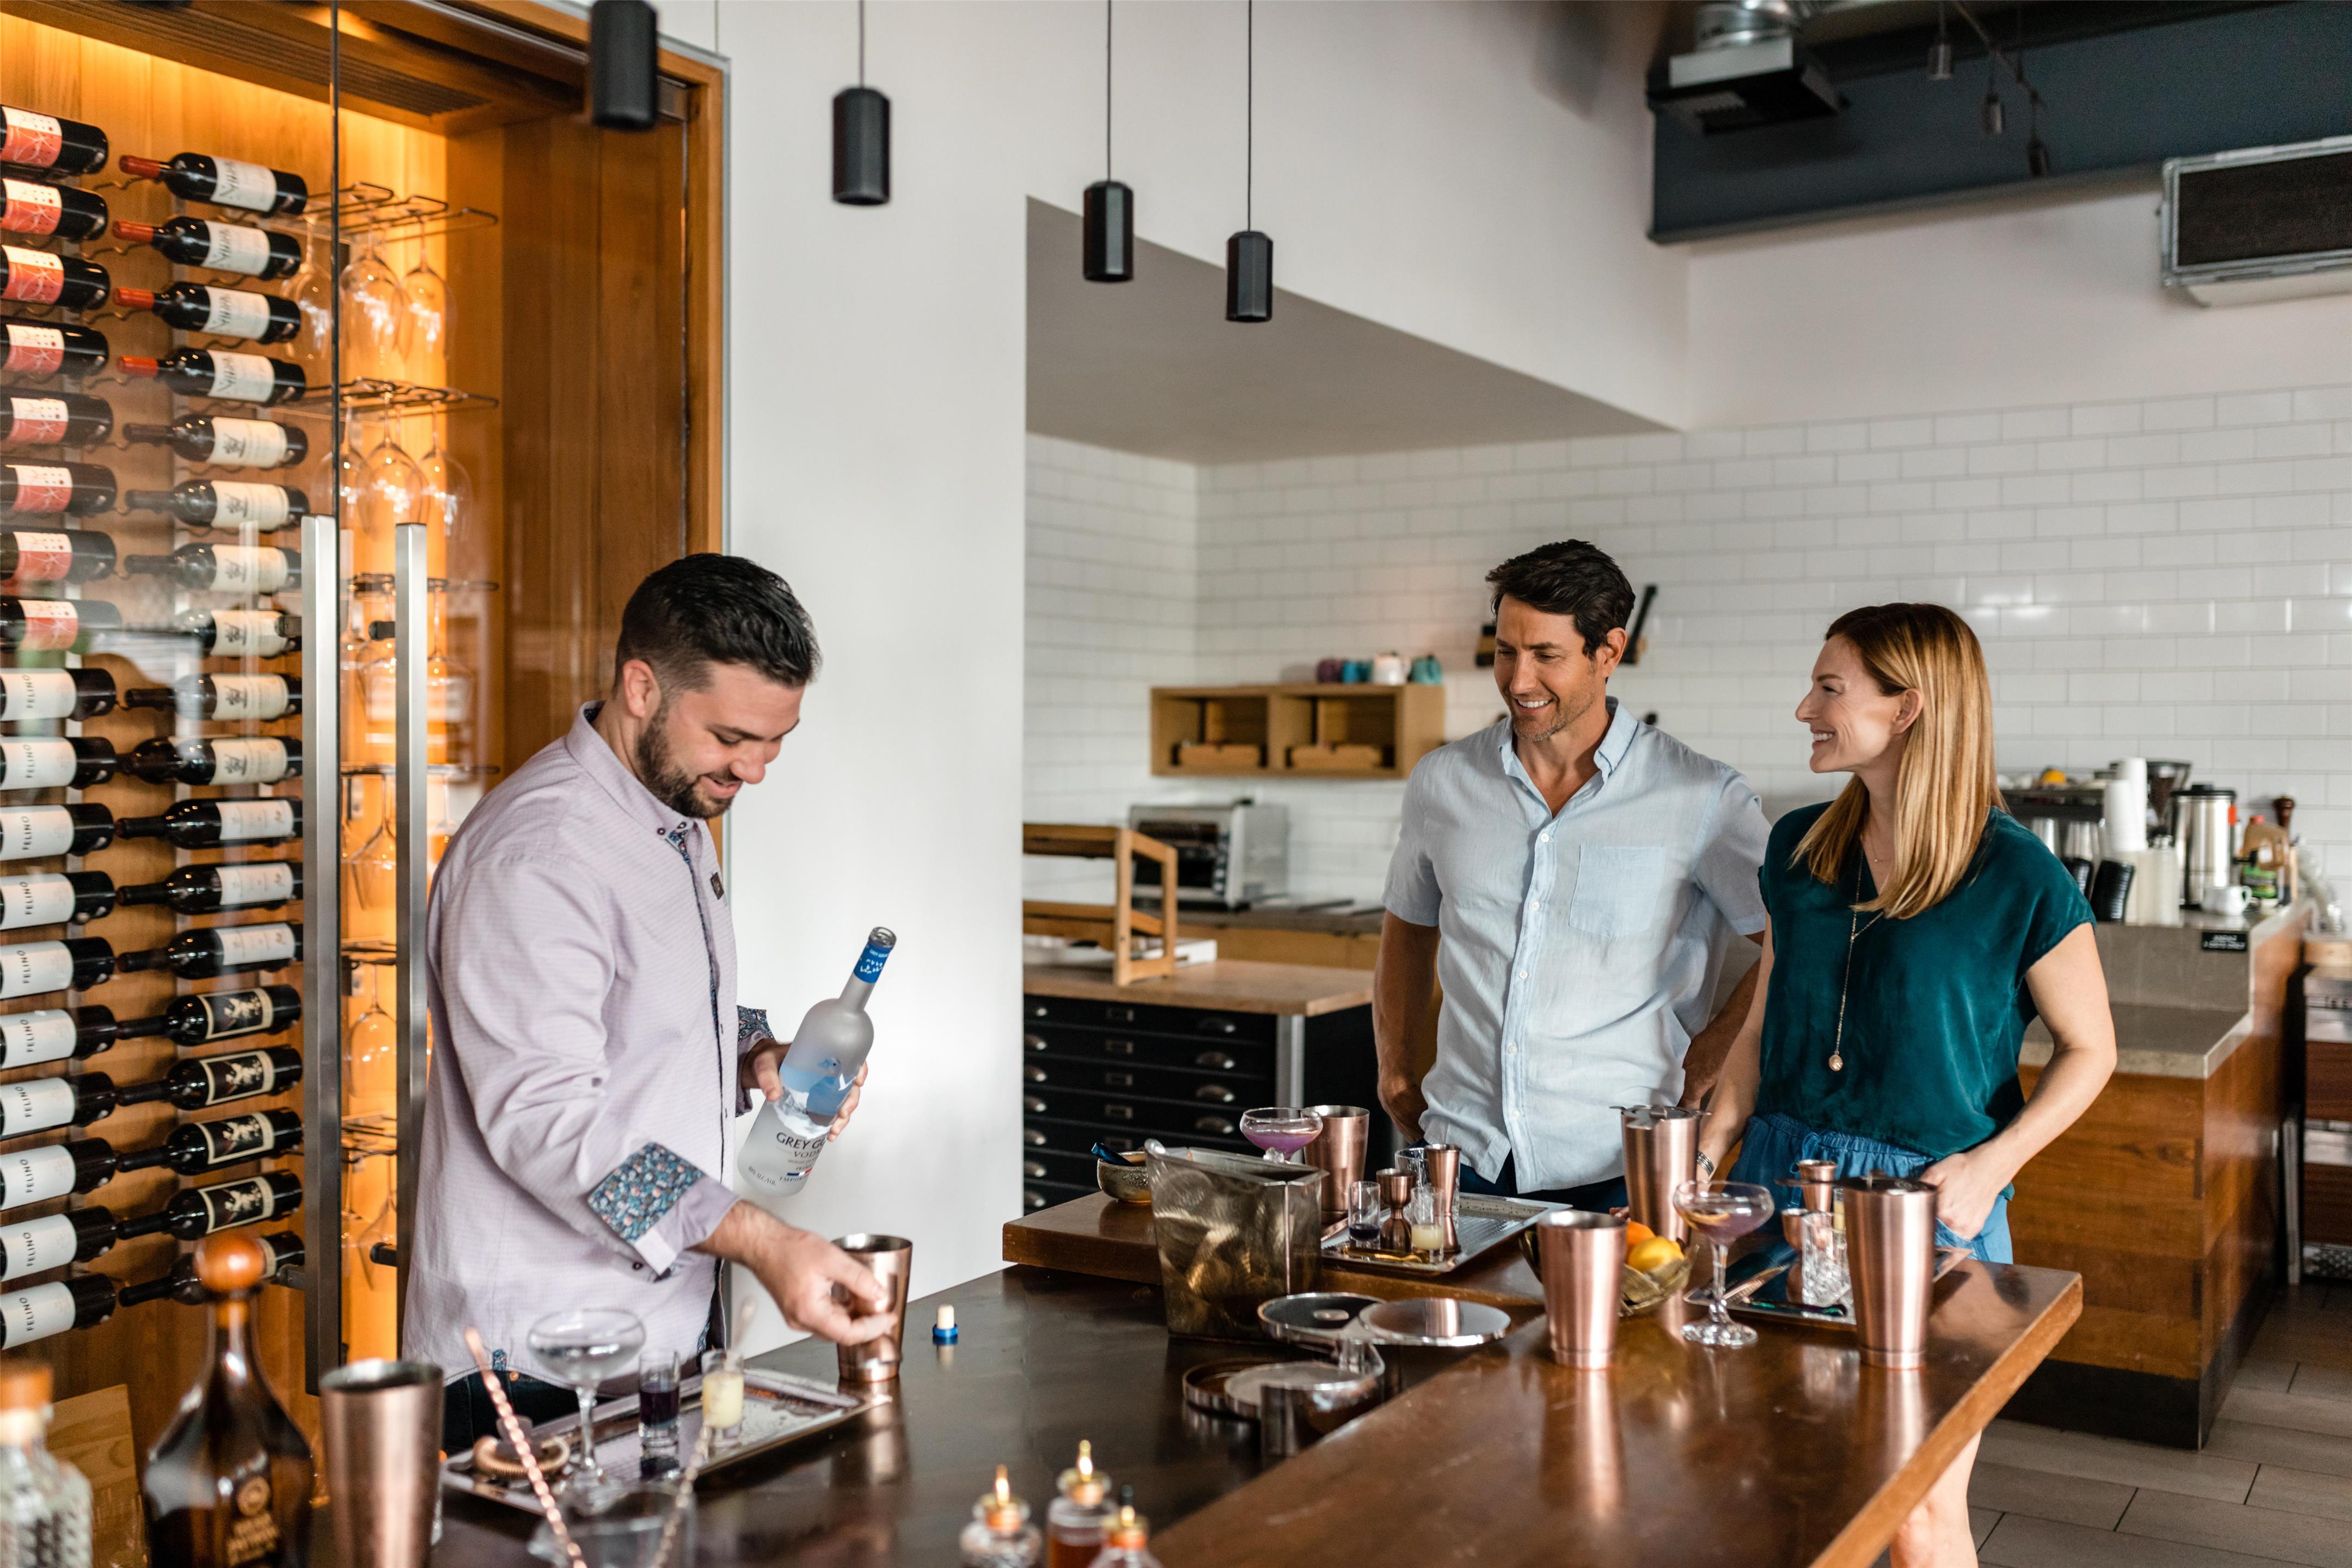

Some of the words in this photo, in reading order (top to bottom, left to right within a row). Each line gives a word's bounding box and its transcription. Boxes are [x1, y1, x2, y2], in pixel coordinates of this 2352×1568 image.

[22, 675, 34, 708] FELINO
[23, 744, 34, 778] FELINO
[21, 817, 32, 850] FELINO
[20, 881, 33, 915] FELINO
[17, 951, 30, 983] FELINO
[20, 1019, 34, 1052] FELINO
[15, 1087, 32, 1117] FELINO
[776, 1132, 811, 1149] GREY
[20, 1159, 34, 1193] FELINO
[23, 1232, 35, 1266] FELINO
[20, 1297, 34, 1331] FELINO
